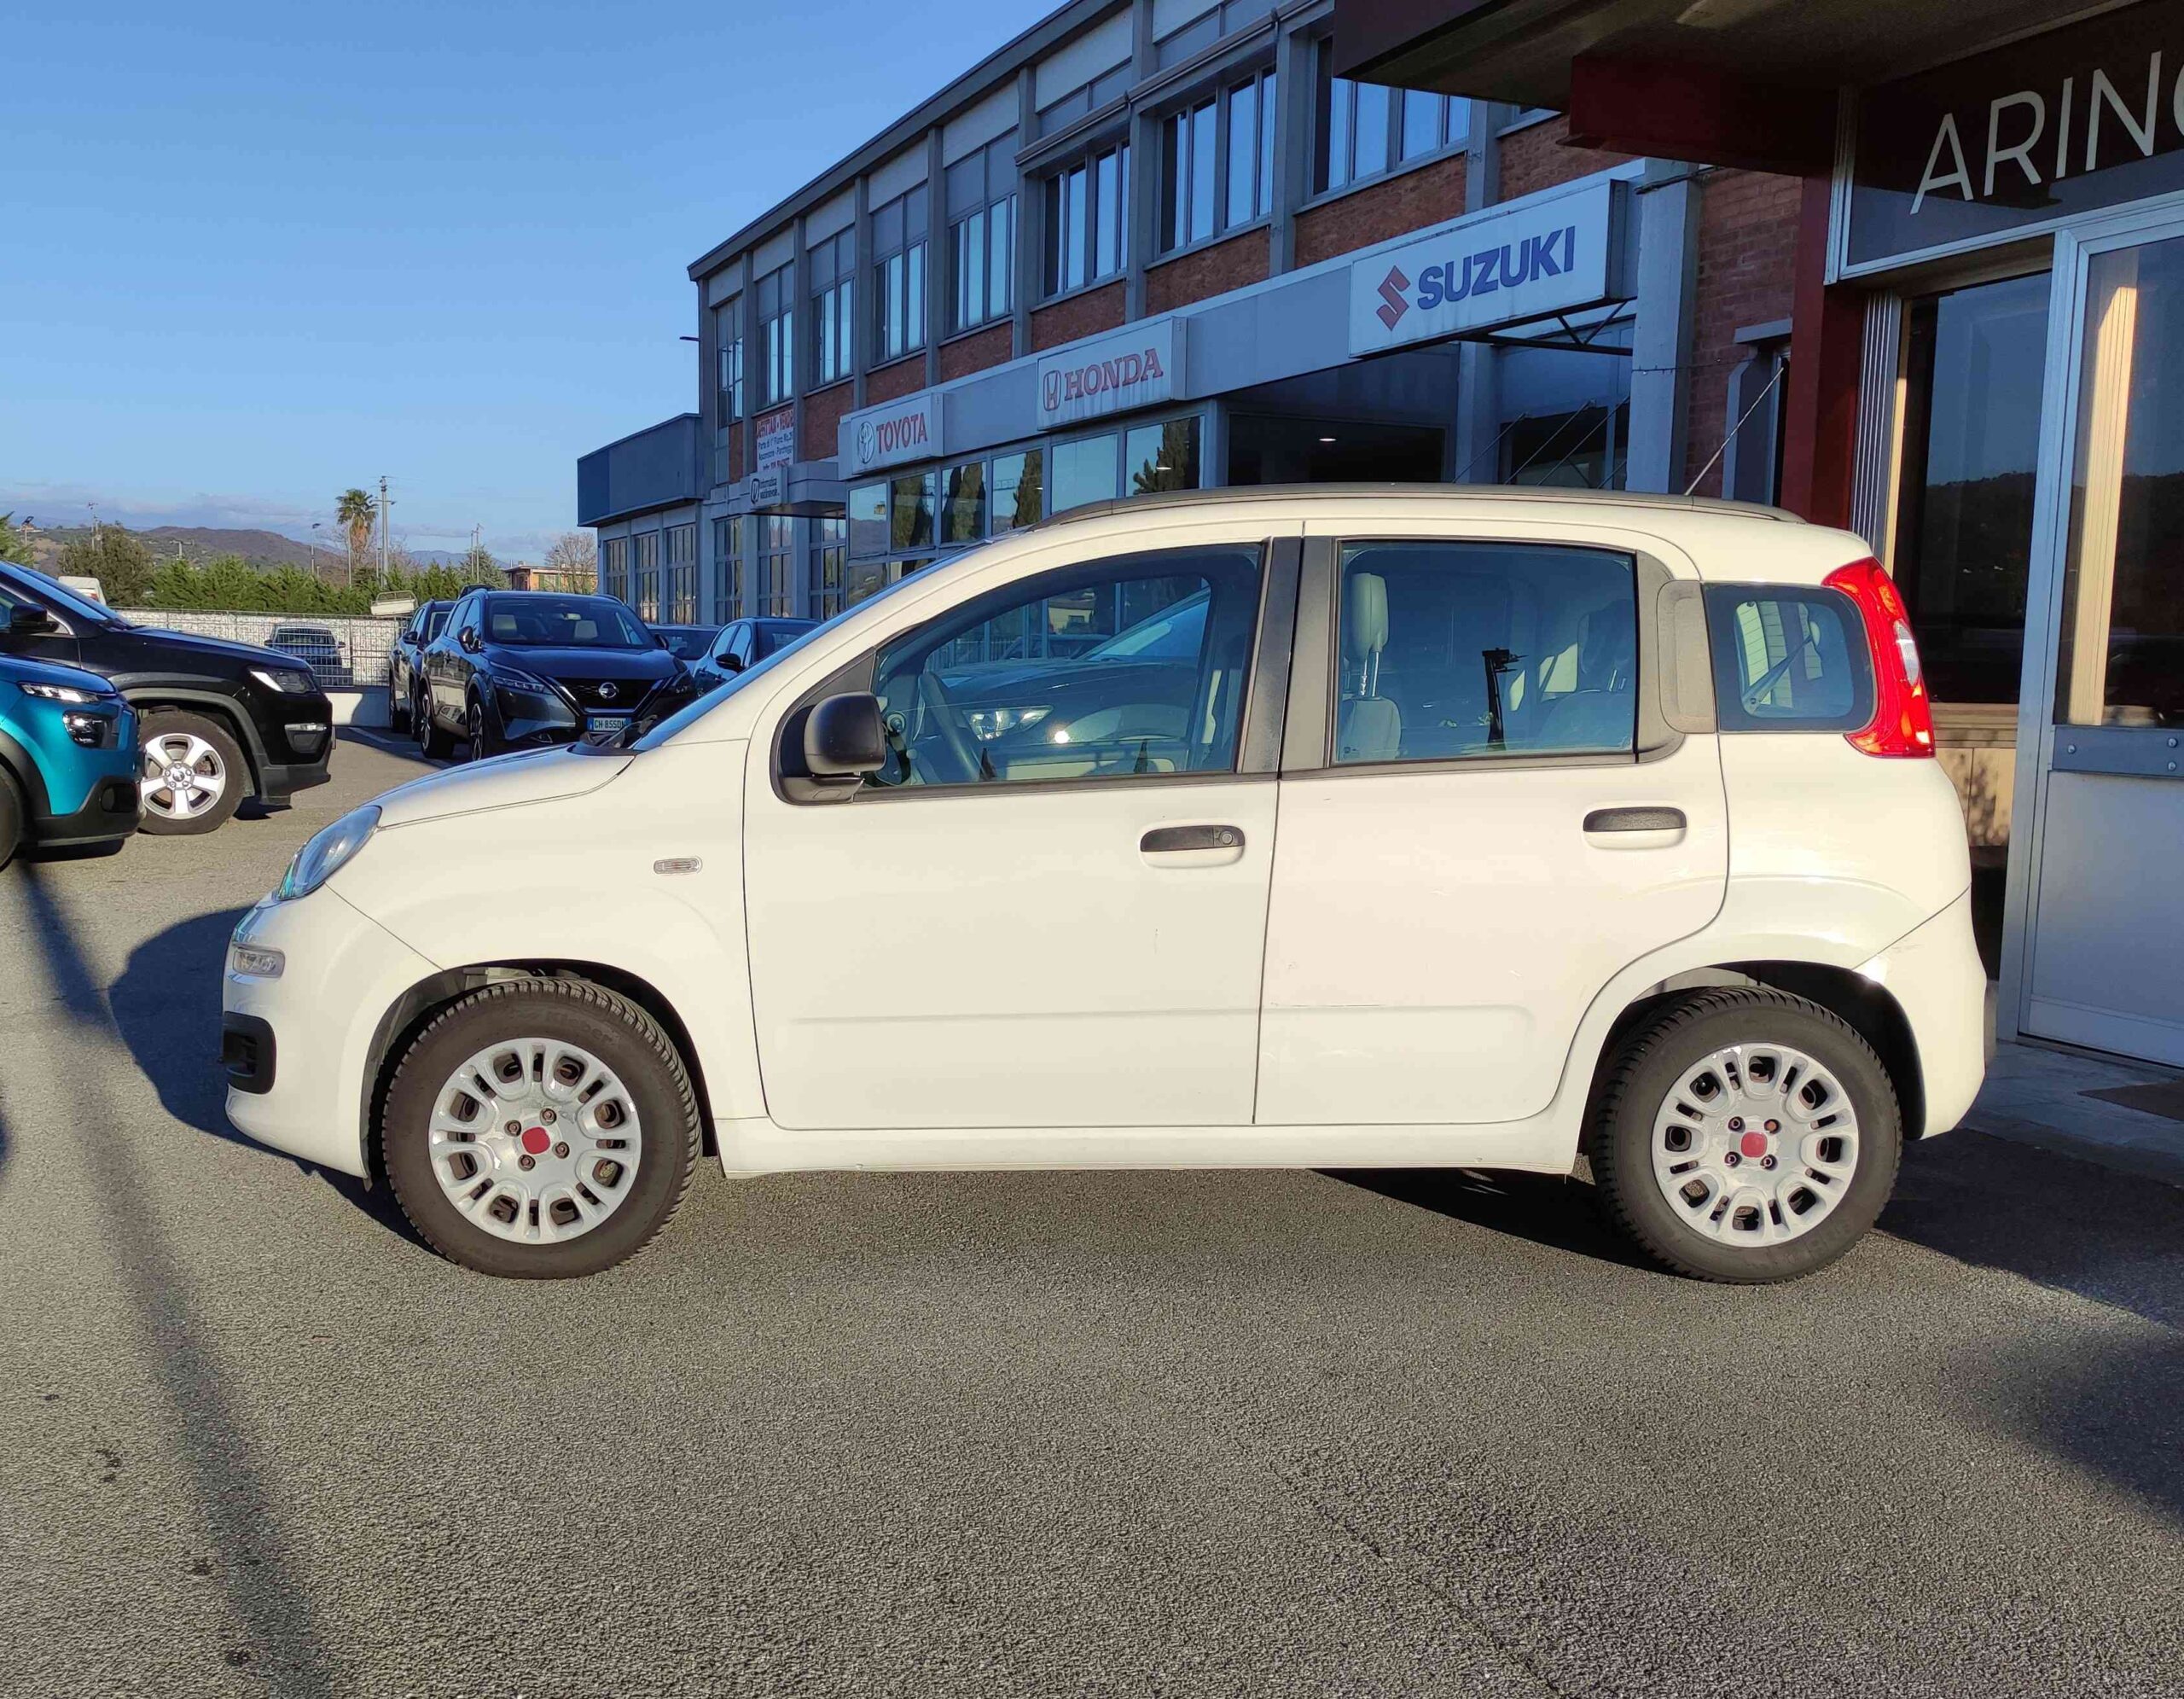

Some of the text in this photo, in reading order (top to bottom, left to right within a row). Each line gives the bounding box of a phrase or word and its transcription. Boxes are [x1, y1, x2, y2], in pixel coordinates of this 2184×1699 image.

[1908, 49, 2184, 215] ARIN
[1416, 225, 1576, 310] SUZUKI
[1064, 347, 1164, 401] HONDA
[876, 412, 928, 455] TOYOTA
